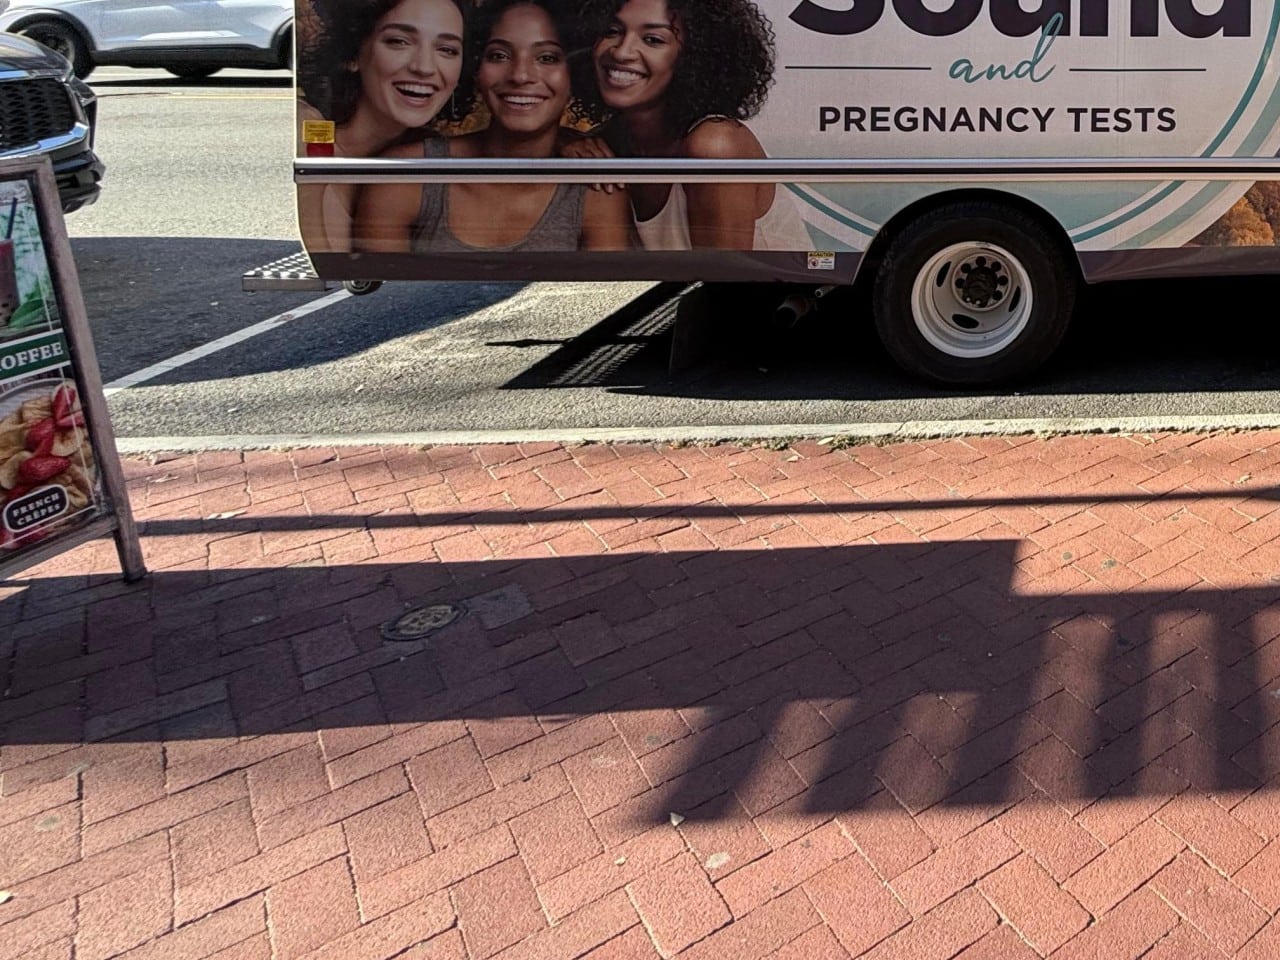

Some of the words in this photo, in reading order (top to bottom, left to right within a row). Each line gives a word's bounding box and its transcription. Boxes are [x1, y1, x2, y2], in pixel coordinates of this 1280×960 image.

[949, 12, 1064, 83] and
[819, 106, 1056, 133] PREGNANCY
[1067, 107, 1177, 133] TESTS
[0, 341, 64, 371] OFFEE
[12, 493, 60, 517] FRENCH
